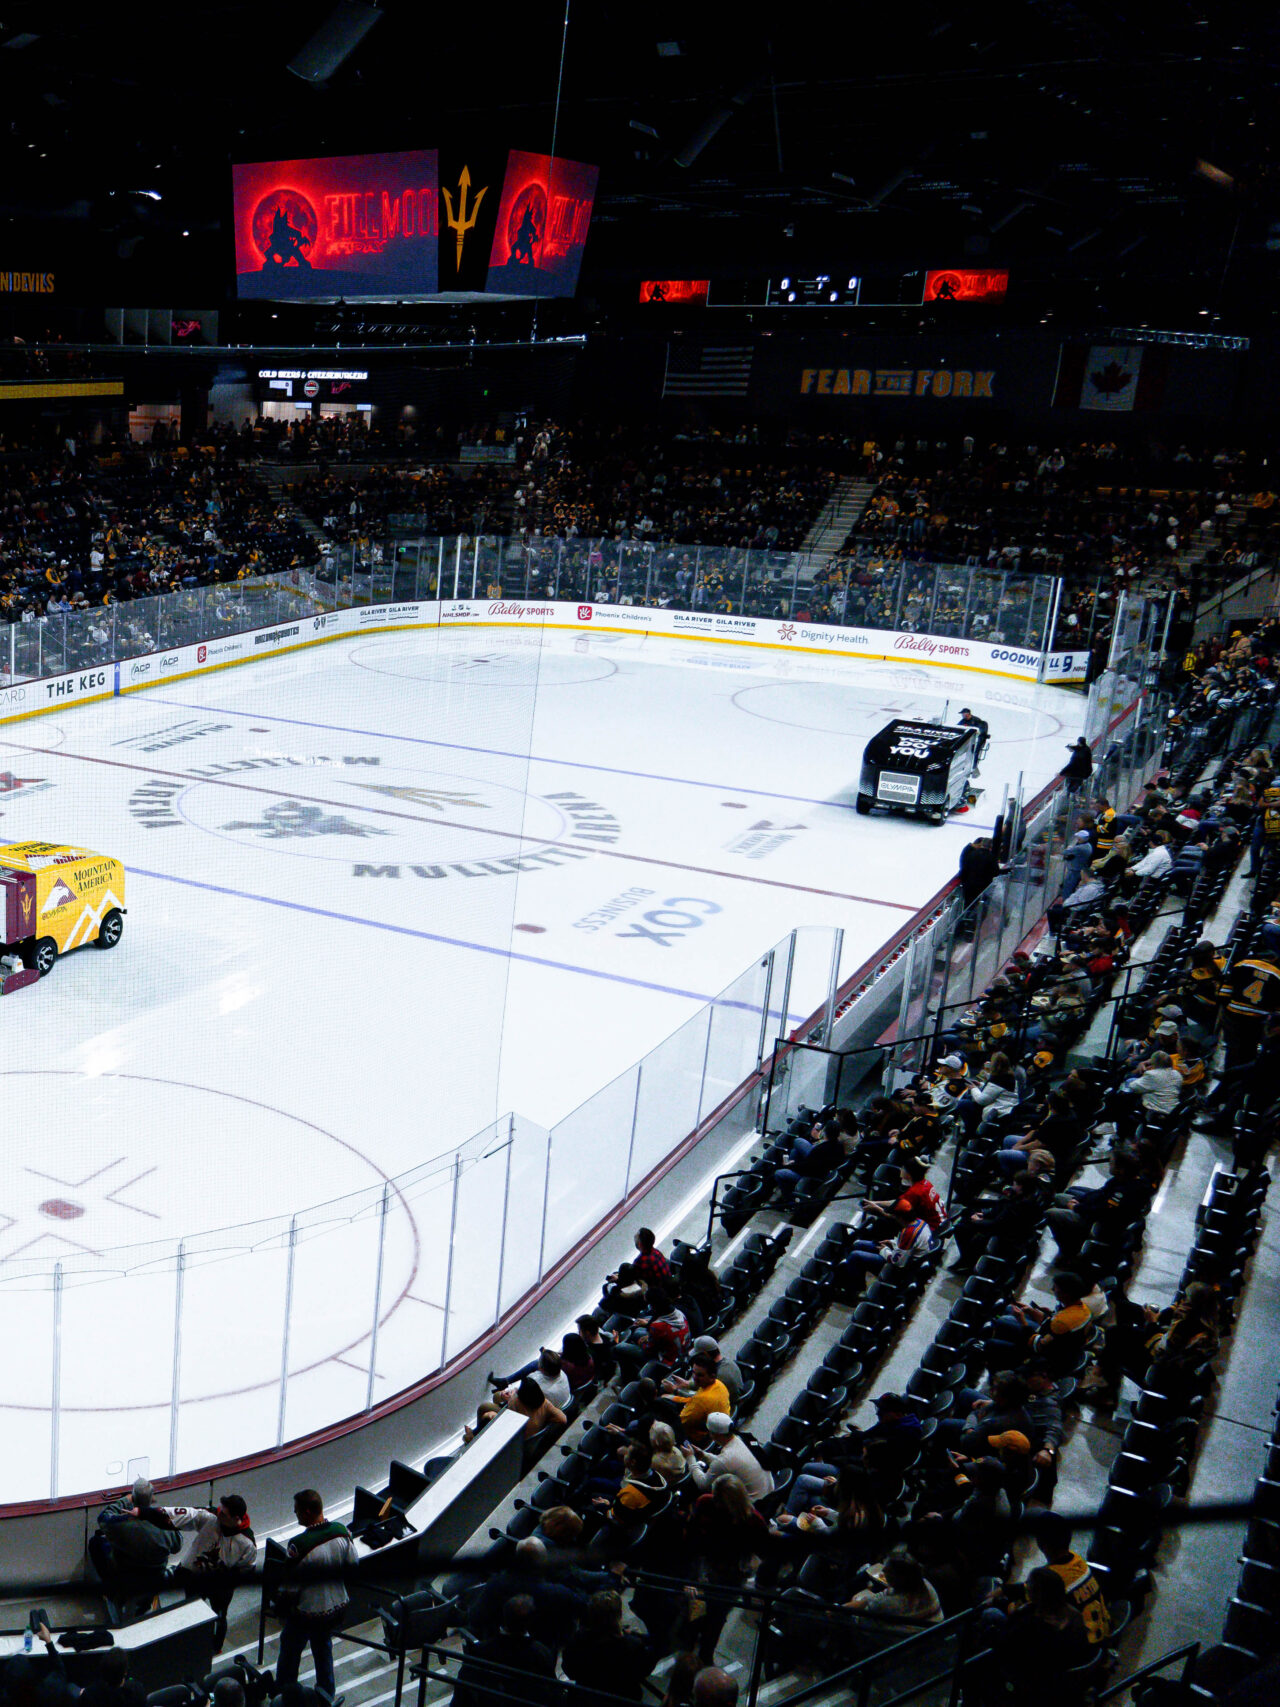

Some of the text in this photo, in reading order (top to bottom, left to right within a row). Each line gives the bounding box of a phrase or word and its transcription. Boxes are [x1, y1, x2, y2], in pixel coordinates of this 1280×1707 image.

[13, 272, 54, 293] DEVILS
[258, 370, 277, 378] COLD
[800, 369, 995, 397] FEAR THE FORK
[488, 602, 555, 618] Bally SPORTS
[595, 611, 652, 622] Phoenix Children's
[673, 614, 691, 622] GILA
[716, 618, 733, 626] GILA
[801, 629, 869, 644] Dignity Health
[894, 634, 970, 656] Bally SPORTS
[134, 663, 151, 673] ACP
[163, 656, 179, 666] ACP
[47, 672, 106, 698] THE KEG
[898, 741, 928, 749] DO
[899, 736, 941, 746] YOU
[890, 746, 930, 758] YOU
[881, 783, 916, 793] OLYMPIA
[352, 848, 589, 879] MULLETT
[73, 860, 116, 883] MOUNTAIN
[77, 872, 113, 892] AMERICA
[572, 886, 656, 932] BUSINESS
[615, 896, 724, 947] COX
[1242, 980, 1265, 1004] 4
